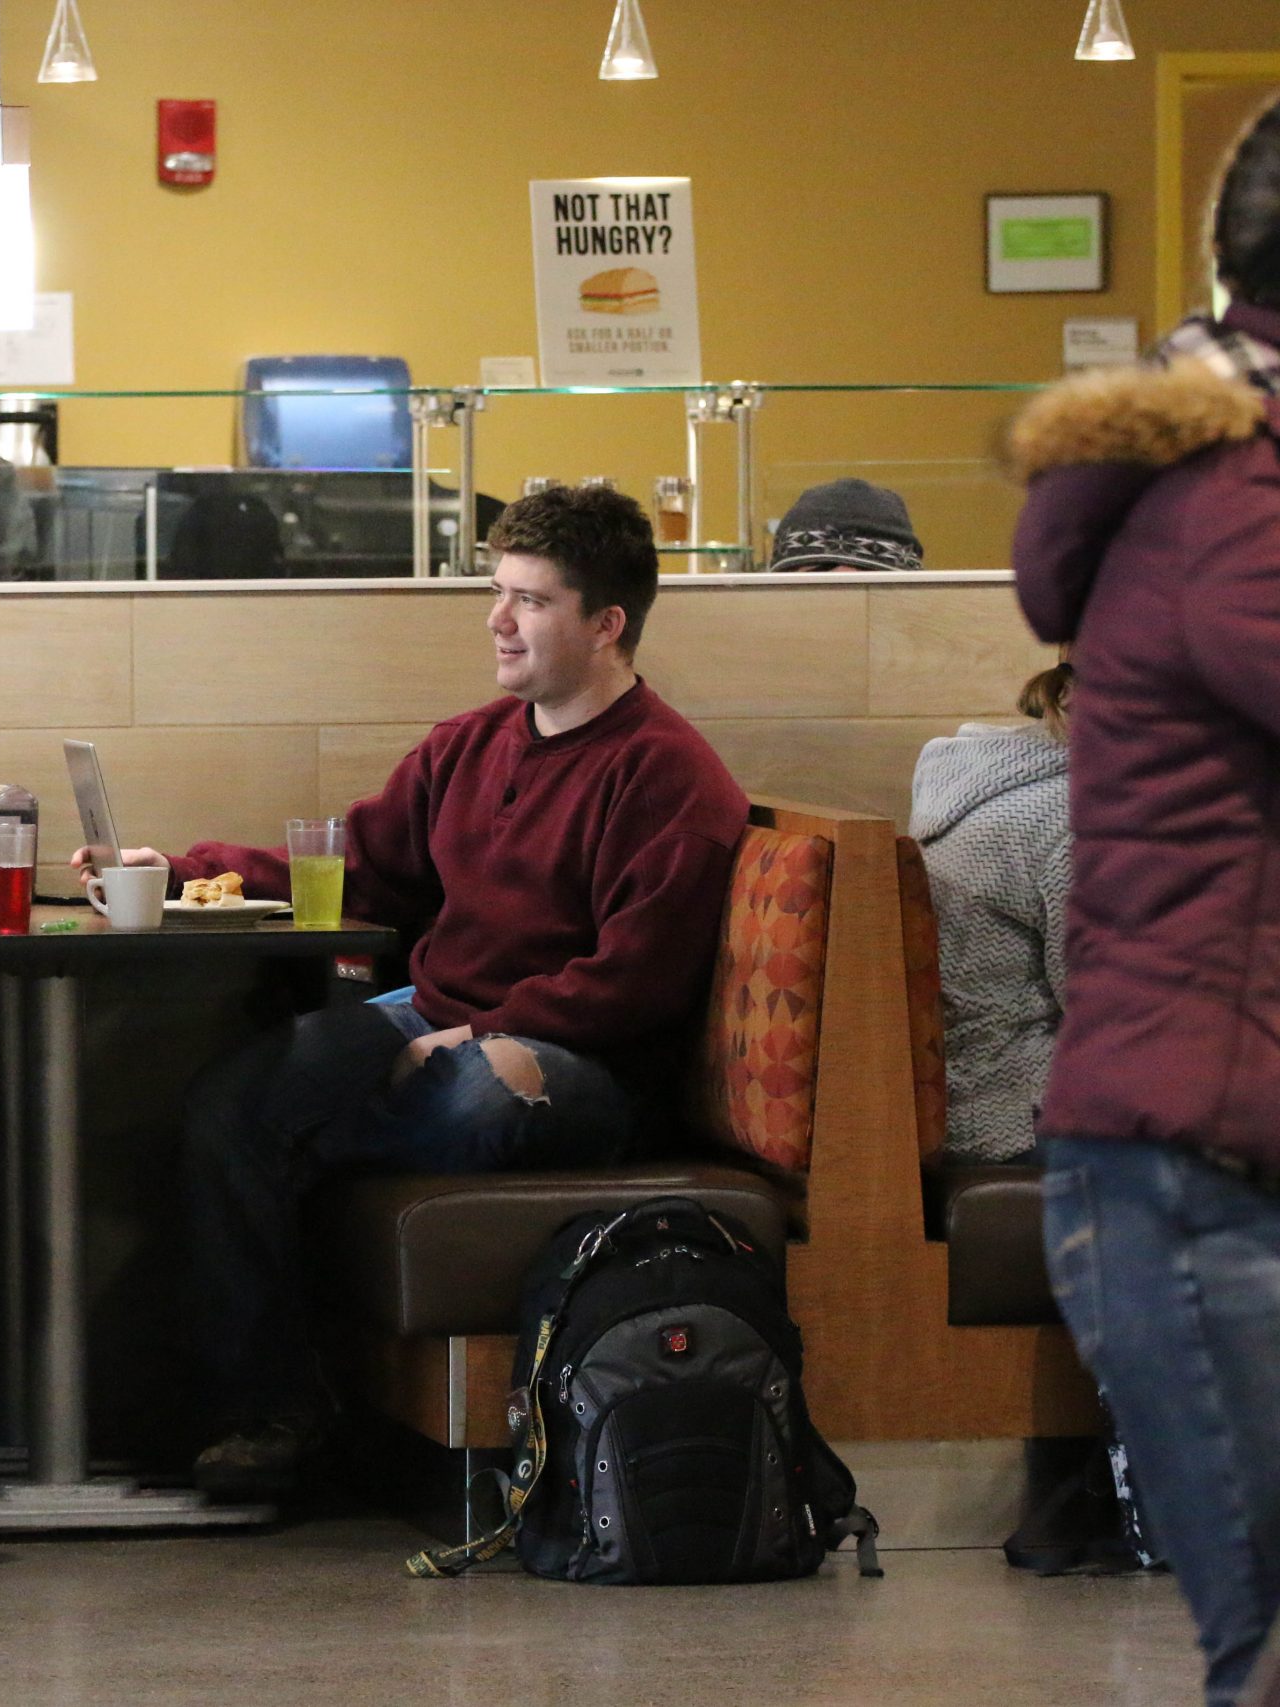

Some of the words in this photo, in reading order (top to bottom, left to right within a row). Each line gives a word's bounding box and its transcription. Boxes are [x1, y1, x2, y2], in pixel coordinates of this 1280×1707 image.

[554, 194, 599, 221] NOT
[610, 193, 671, 221] THAT
[557, 226, 672, 255] HUNGRY?
